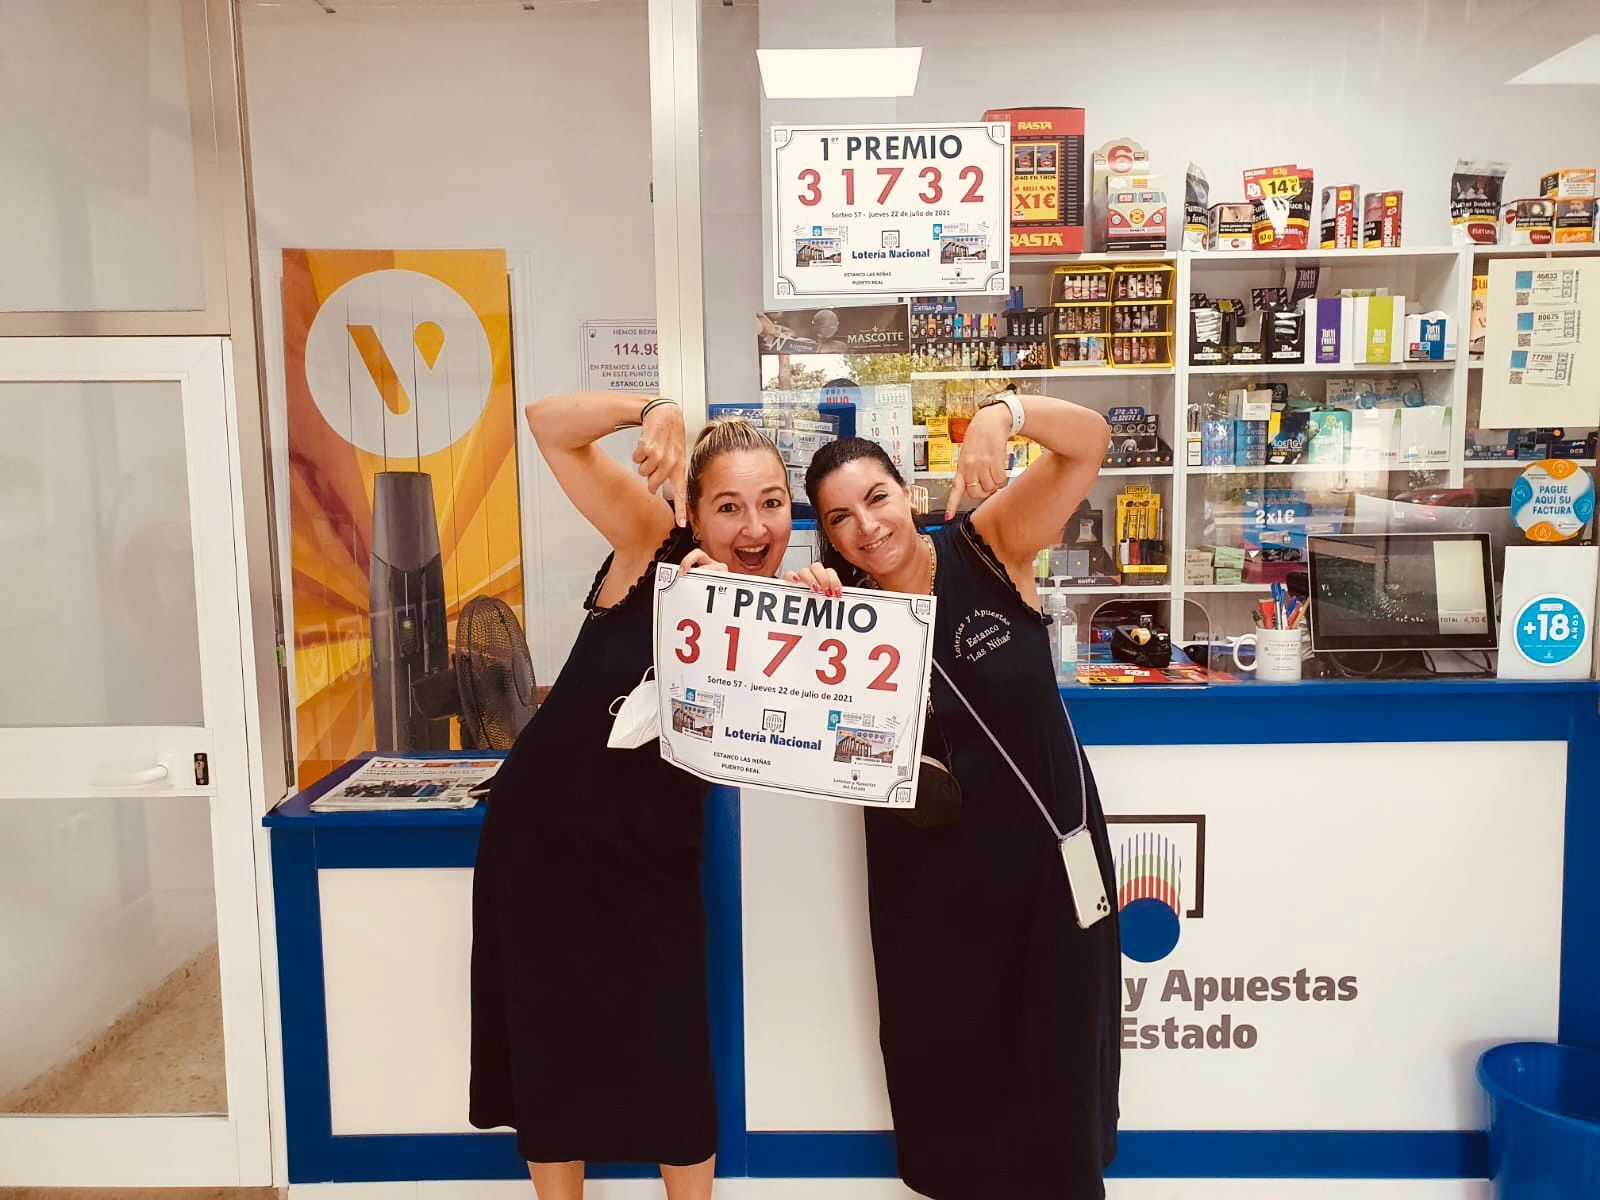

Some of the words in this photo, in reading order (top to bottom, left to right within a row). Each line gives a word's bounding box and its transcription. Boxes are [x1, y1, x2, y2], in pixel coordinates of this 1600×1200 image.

[1018, 121, 1052, 130] RASTA
[846, 134, 962, 161] PREMIO
[1108, 145, 1133, 174] 6
[1272, 167, 1288, 176] 83g
[797, 165, 984, 206] 31732
[1268, 179, 1289, 195] 14
[1014, 192, 1056, 209] X1€
[831, 211, 852, 219] Sorteo
[868, 211, 890, 219] jueves
[909, 209, 924, 218] julio
[935, 209, 950, 217] 2021
[1010, 233, 1063, 247] RASTA
[851, 249, 886, 259] Lotería
[888, 248, 930, 258] Nacional
[847, 331, 904, 344] MASCOTTE
[872, 413, 877, 422] 3
[892, 412, 897, 421] 4
[871, 427, 880, 437] 10
[891, 426, 899, 436] 11
[892, 440, 900, 450] 18
[892, 454, 902, 464] 25
[1539, 485, 1569, 494] PAGUE
[1534, 494, 1556, 504] AQUÍ
[1559, 495, 1571, 504] SU
[1533, 506, 1571, 515] FACTURA
[733, 588, 878, 633] PREMIO
[973, 608, 1011, 627] Apuestas
[1464, 616, 1480, 624] 4,70
[1523, 613, 1570, 641] +18
[1570, 614, 1579, 640] AÑOS
[965, 623, 1000, 648] Estanco
[674, 618, 902, 692] 31732
[707, 675, 732, 687] Sorteo
[732, 680, 743, 688] 57
[750, 682, 777, 694] jueves
[778, 686, 788, 695] 22
[790, 688, 800, 696] de
[800, 688, 819, 699] julio
[821, 691, 832, 700] de
[833, 693, 853, 703] 2021
[725, 726, 766, 743] Lotería
[769, 733, 822, 751] Nacional
[713, 751, 739, 761] ESTANCO
[739, 755, 751, 763] LAS
[751, 756, 771, 766] NIÑAS
[721, 763, 745, 772] PUERTO
[745, 766, 760, 774] REAL
[1123, 977, 1148, 1012] y
[1159, 967, 1359, 1012] Apuestas
[1120, 1013, 1258, 1050] Estado
